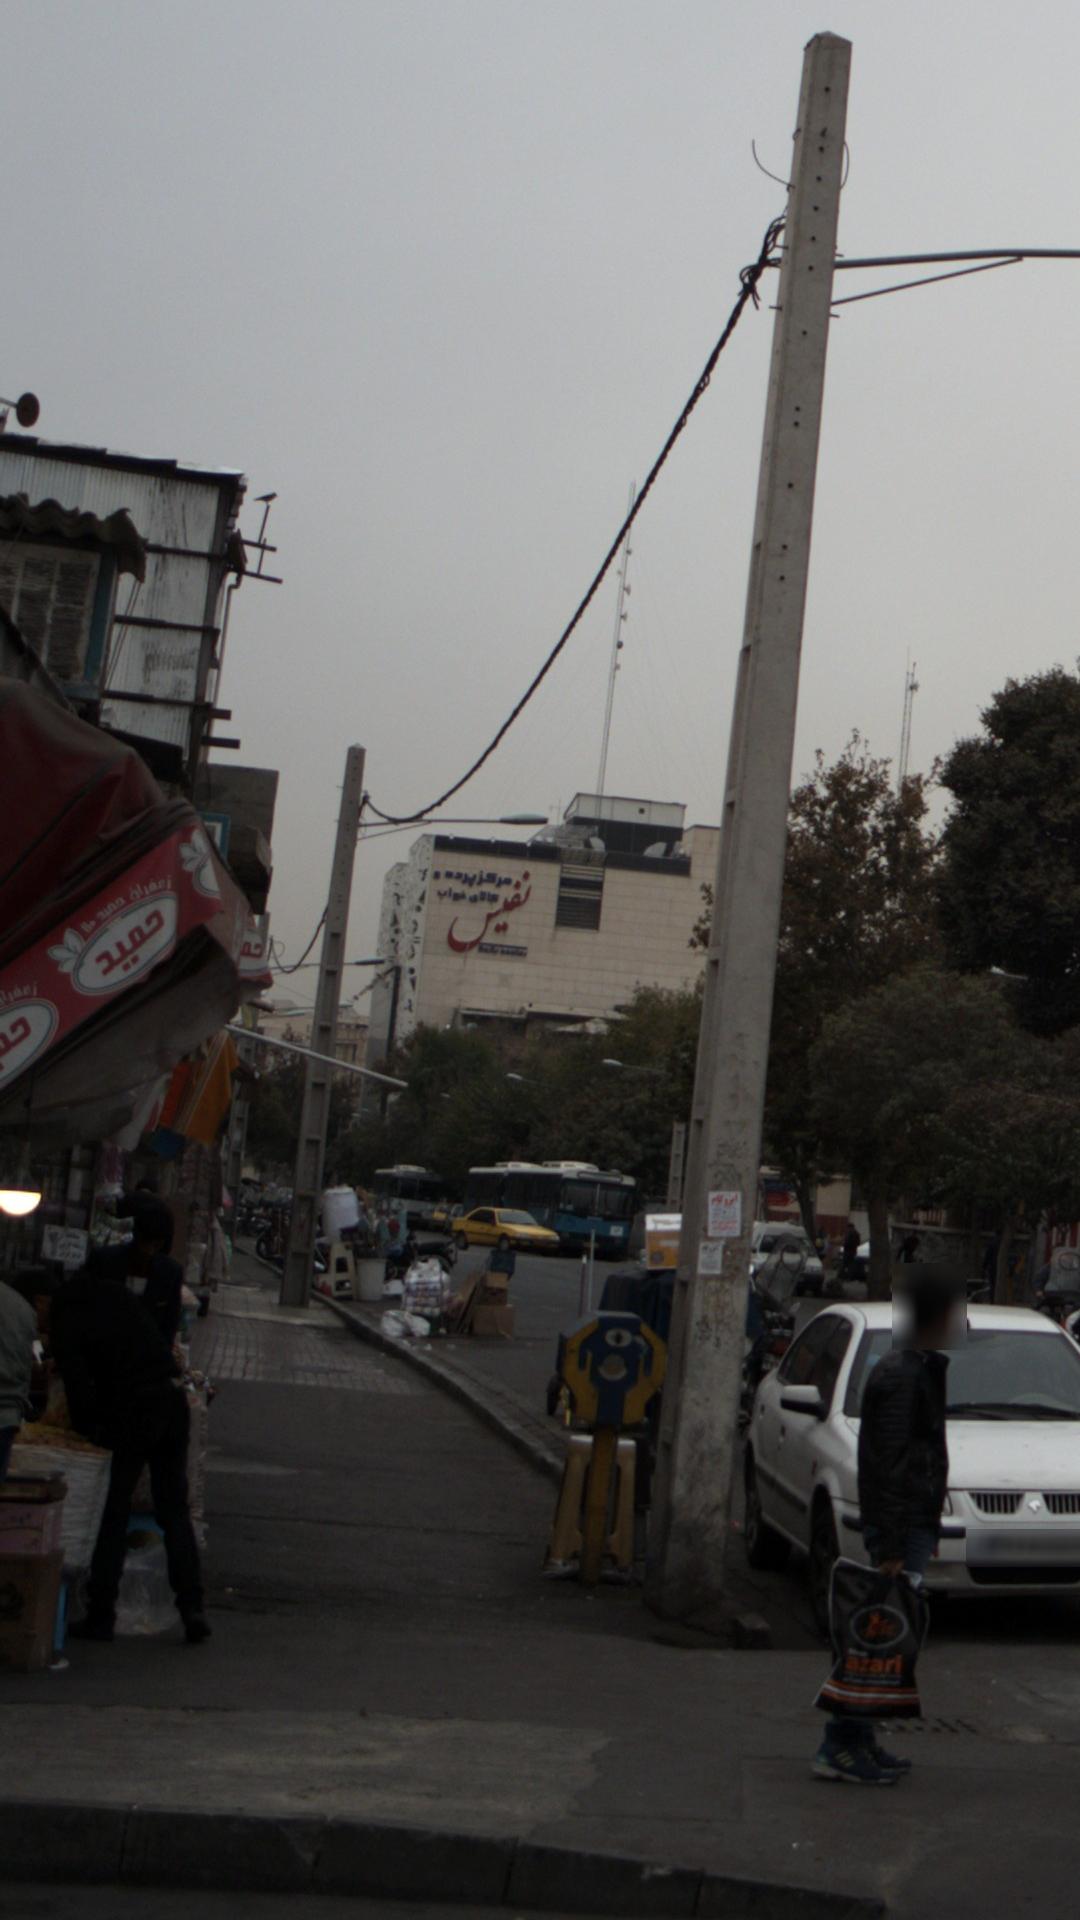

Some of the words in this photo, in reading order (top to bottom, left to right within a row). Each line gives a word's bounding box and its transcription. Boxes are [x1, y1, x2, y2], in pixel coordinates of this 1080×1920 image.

[446, 870, 476, 887] پرده
[477, 871, 512, 888] مرکز
[438, 887, 466, 903] خواب
[468, 890, 500, 904] کالای
[448, 871, 532, 953] نفیس
[95, 909, 166, 977] حمید
